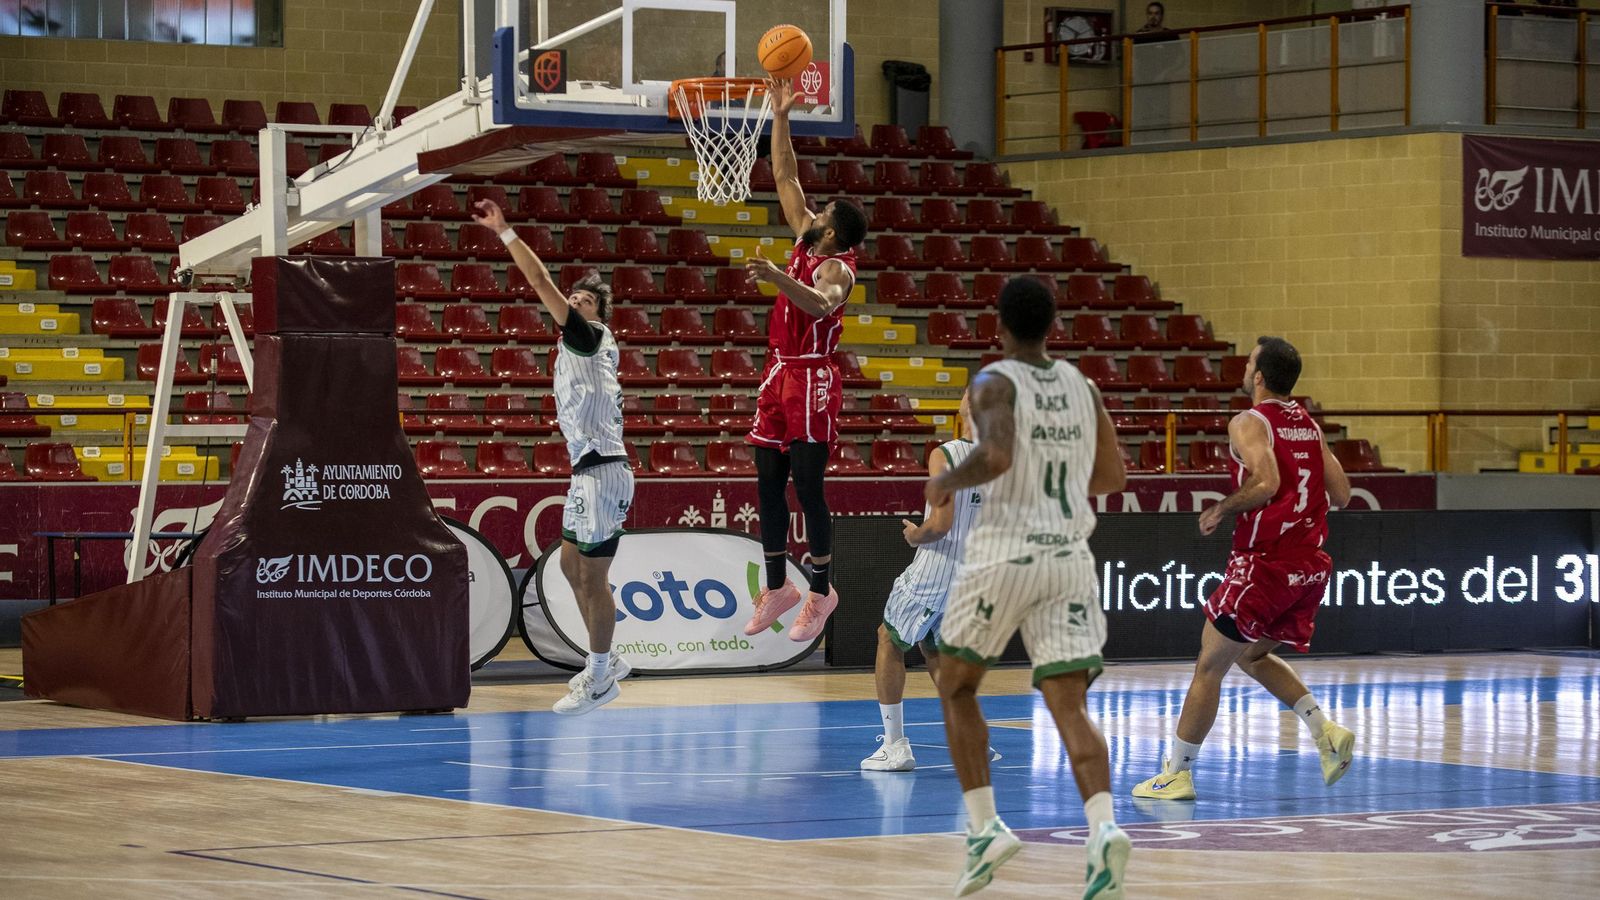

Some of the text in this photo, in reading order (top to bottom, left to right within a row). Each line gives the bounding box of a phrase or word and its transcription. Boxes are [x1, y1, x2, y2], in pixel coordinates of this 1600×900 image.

[1534, 166, 1600, 214] IM
[1475, 222, 1527, 239] Instituto
[1530, 225, 1591, 244] Municipal
[322, 464, 402, 480] AYUNTAMIENTO
[323, 484, 337, 499] DE
[1044, 461, 1073, 519] 4
[1293, 467, 1311, 513] 3
[297, 553, 433, 583] IMDECO
[1461, 555, 1538, 605] del
[257, 587, 431, 600] Instituto Municipal de Deportes Córdoba
[611, 635, 754, 657] ontigo, con todo.
